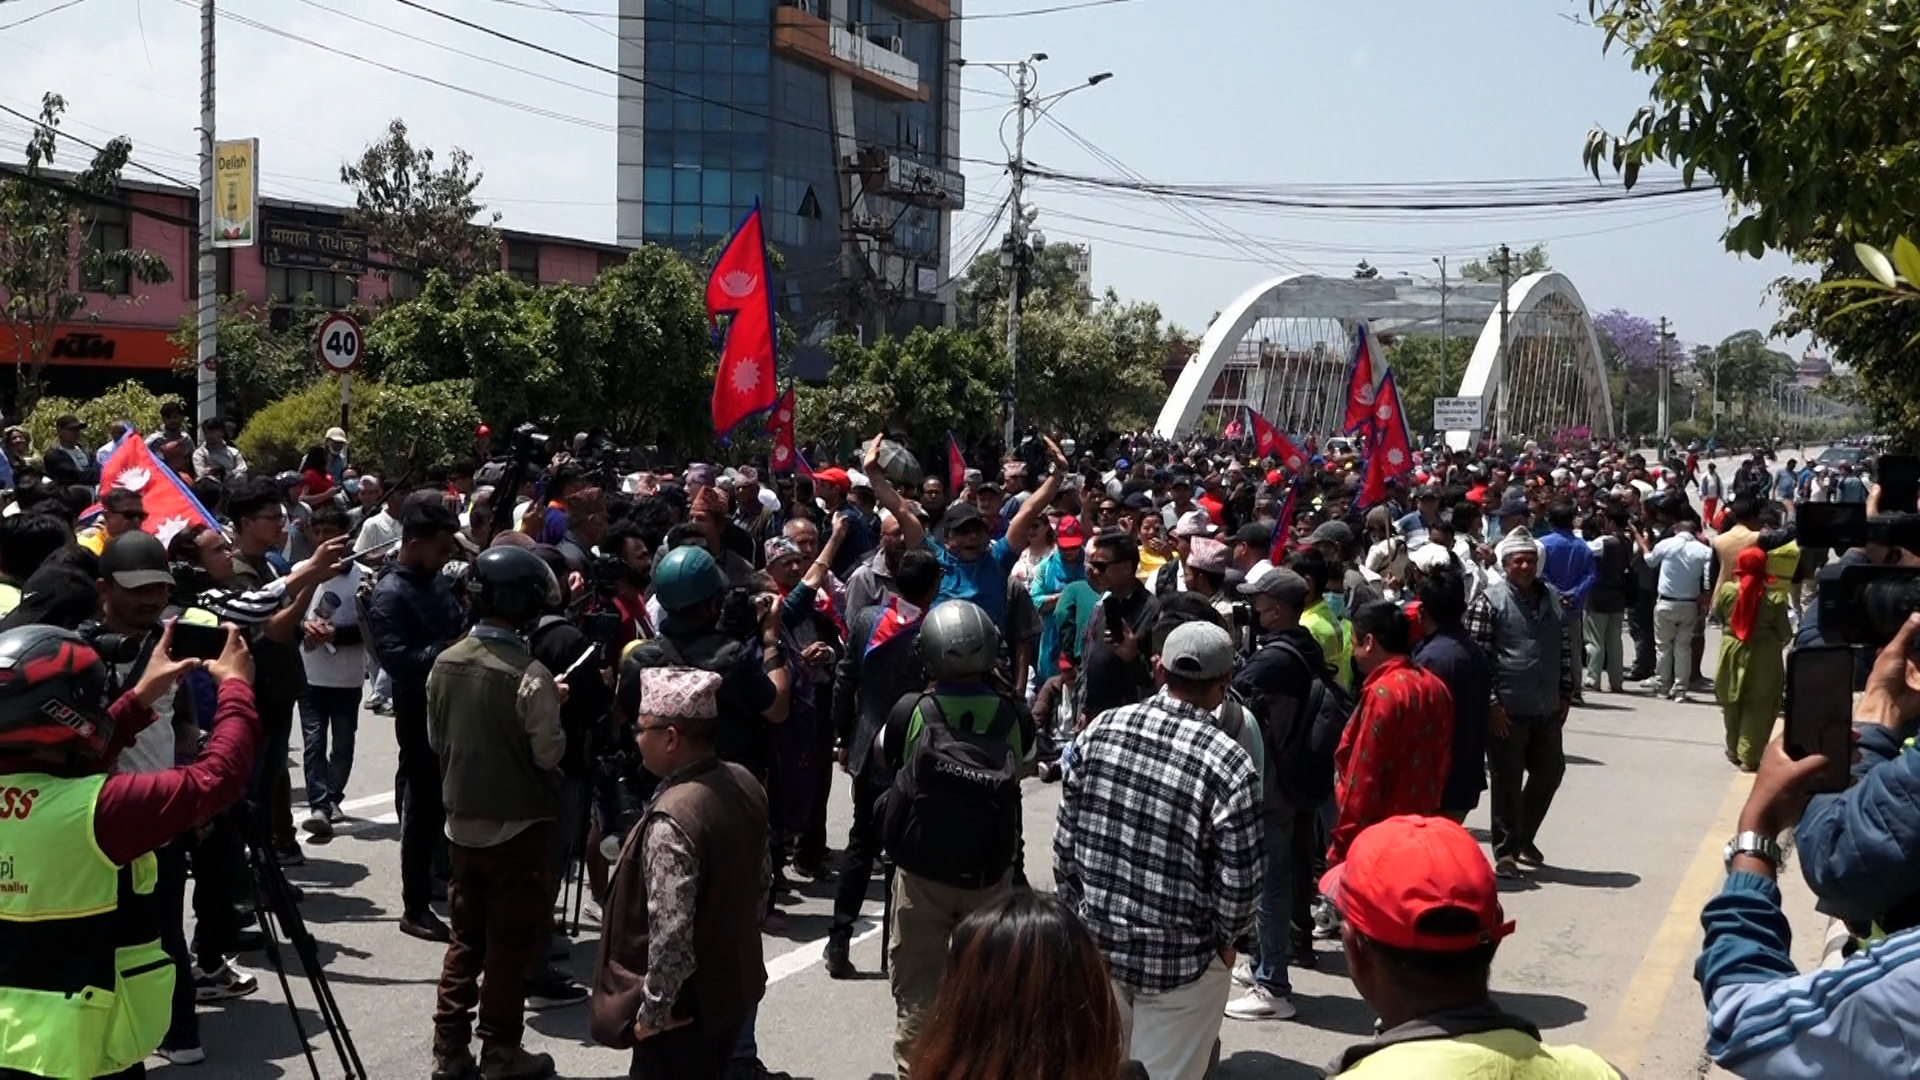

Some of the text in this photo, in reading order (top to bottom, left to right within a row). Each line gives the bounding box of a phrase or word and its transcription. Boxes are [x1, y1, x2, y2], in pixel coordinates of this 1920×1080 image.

[218, 155, 247, 170] Delish
[52, 333, 115, 359] KTM
[326, 331, 356, 356] 40
[0, 786, 40, 820] SS
